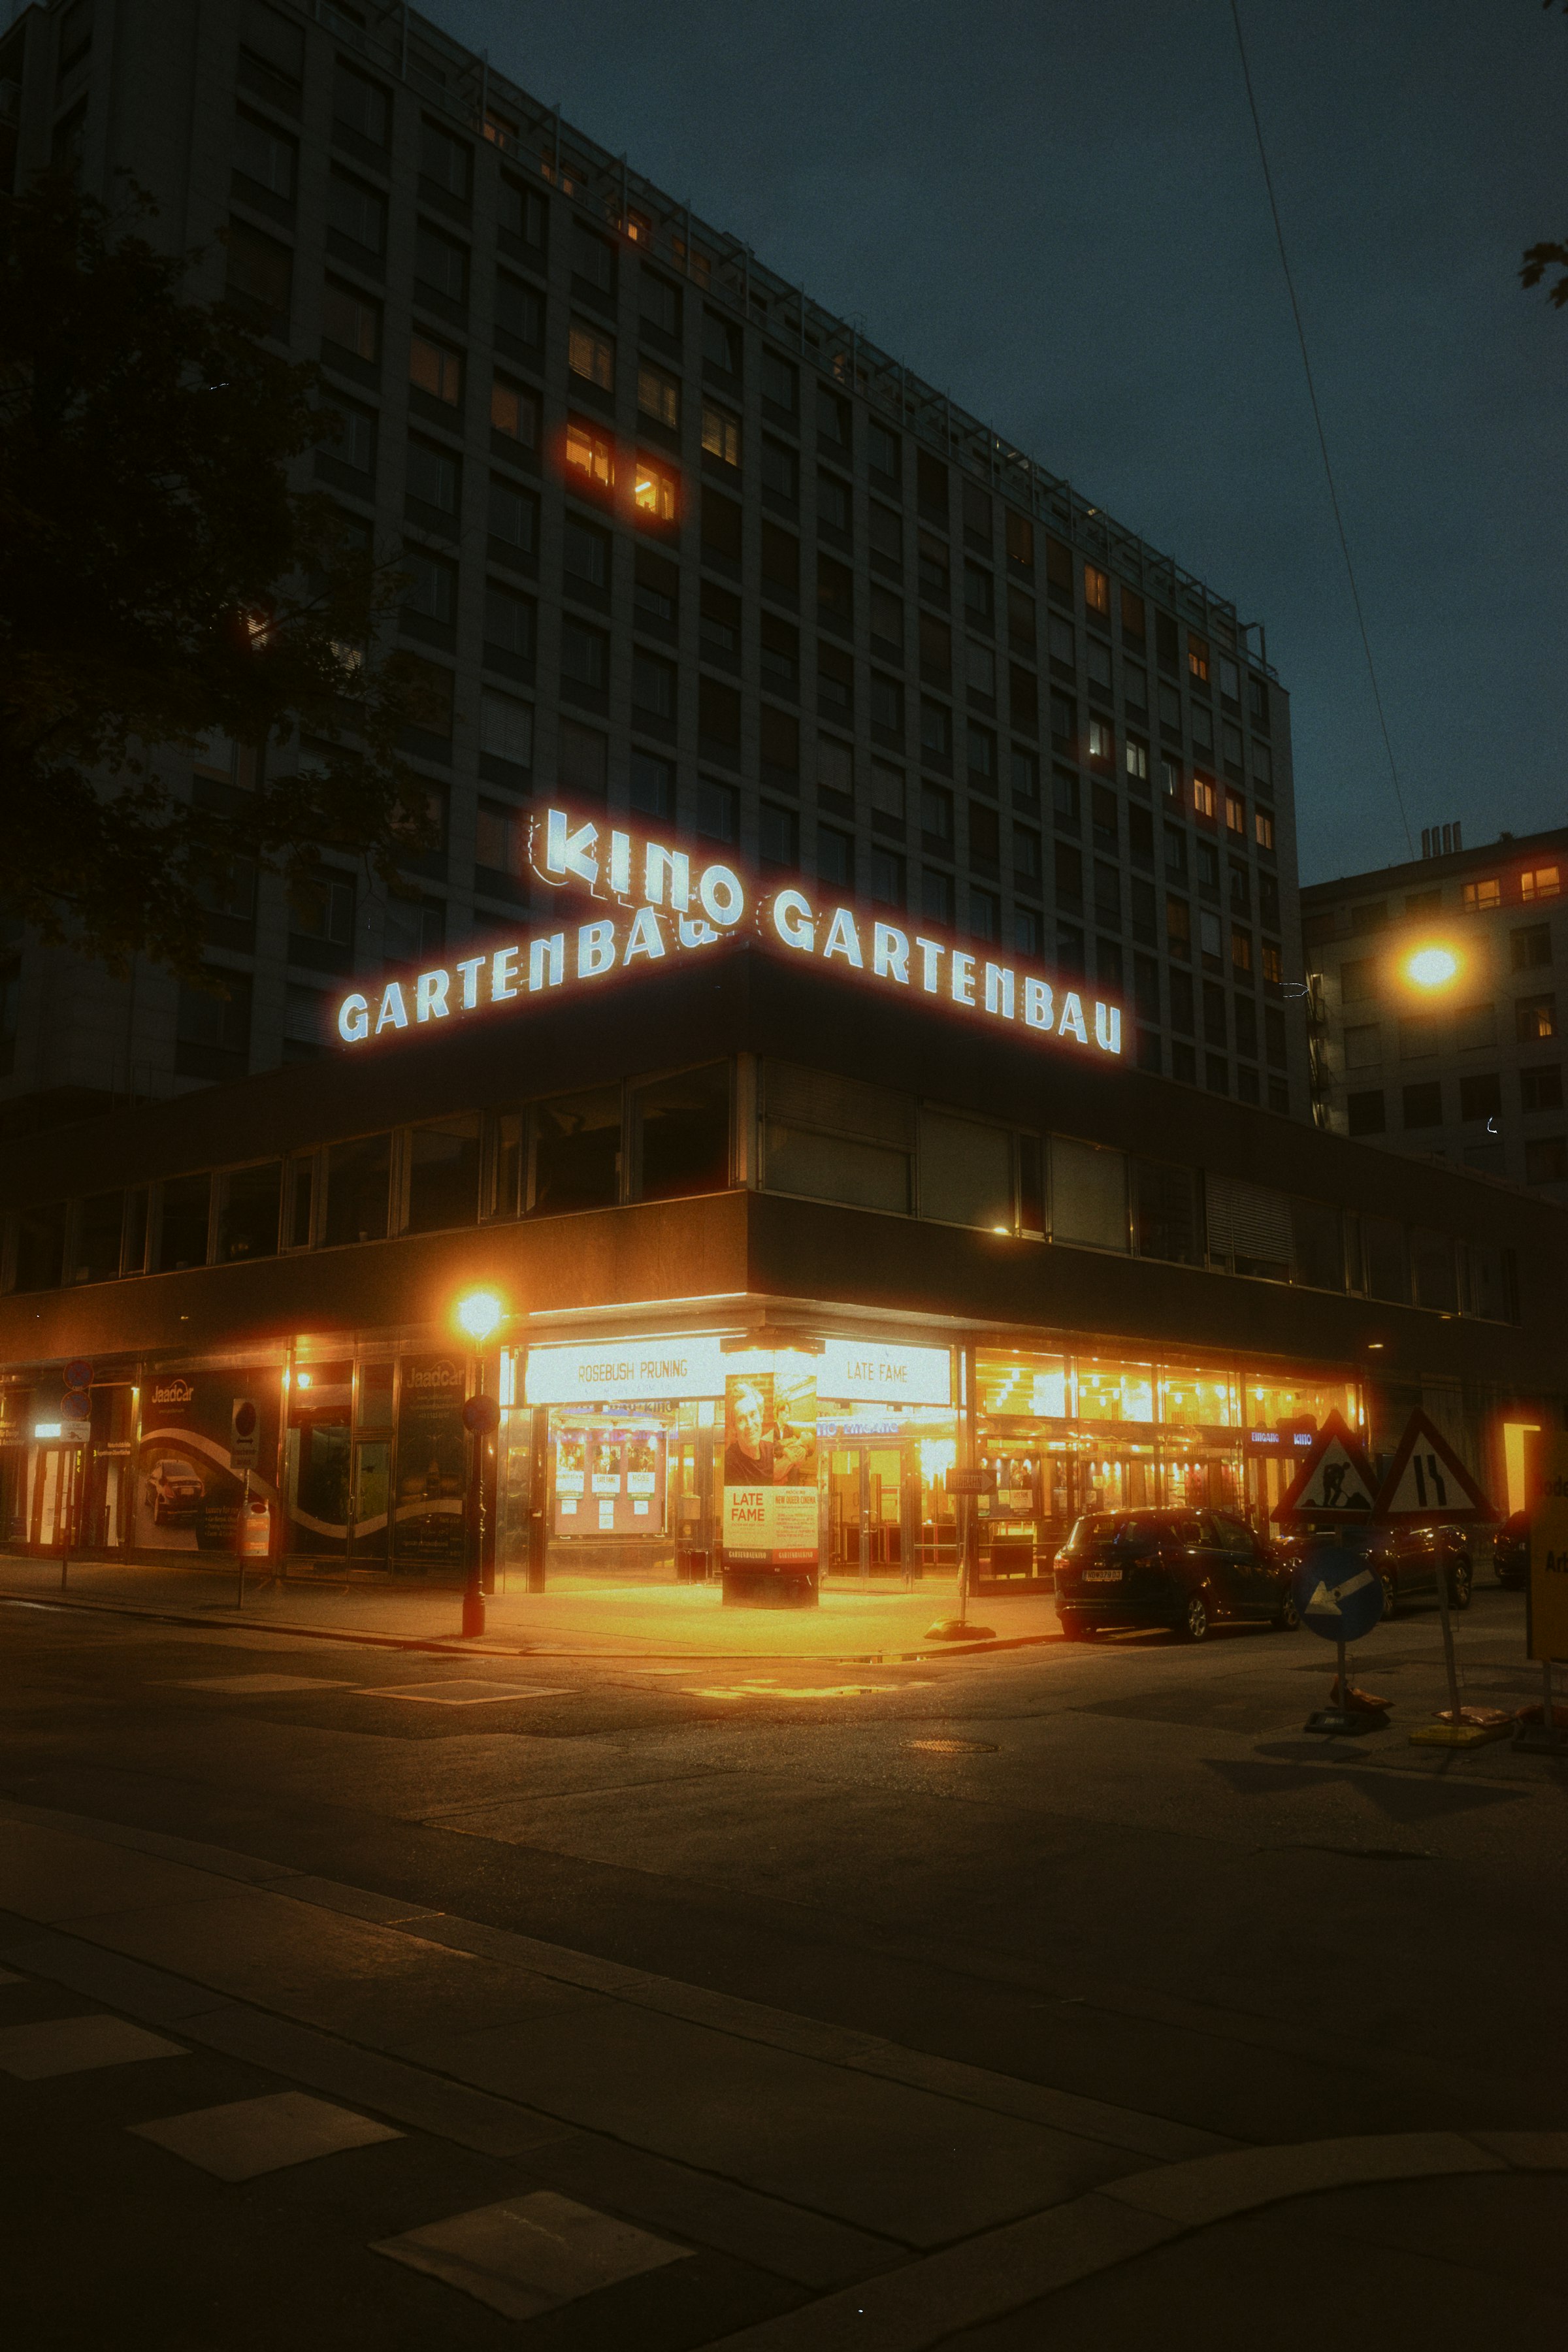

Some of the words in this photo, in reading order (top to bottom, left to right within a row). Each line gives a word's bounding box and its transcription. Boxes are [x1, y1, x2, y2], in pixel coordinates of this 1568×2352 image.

[547, 809, 744, 926] KINO
[774, 889, 1122, 1054] GARTENBAU
[407, 1366, 465, 1388] Jaadcar
[578, 1362, 634, 1382] ROSEBUSH
[640, 1359, 688, 1379] PRUNING
[847, 1361, 874, 1380] LATE
[879, 1364, 908, 1382] FAME
[152, 1383, 193, 1403] Jaadcar
[1251, 1431, 1280, 1443] EINGANG
[1294, 1433, 1312, 1445] KINO
[951, 1475, 983, 1488] EINBAHN
[733, 1492, 763, 1506] LATE
[776, 1495, 785, 1505] NEW
[786, 1496, 800, 1505] QUEER
[800, 1496, 816, 1505] CINEMA
[731, 1508, 765, 1522] FAME
[728, 1551, 767, 1560] GARTENBAUKINO
